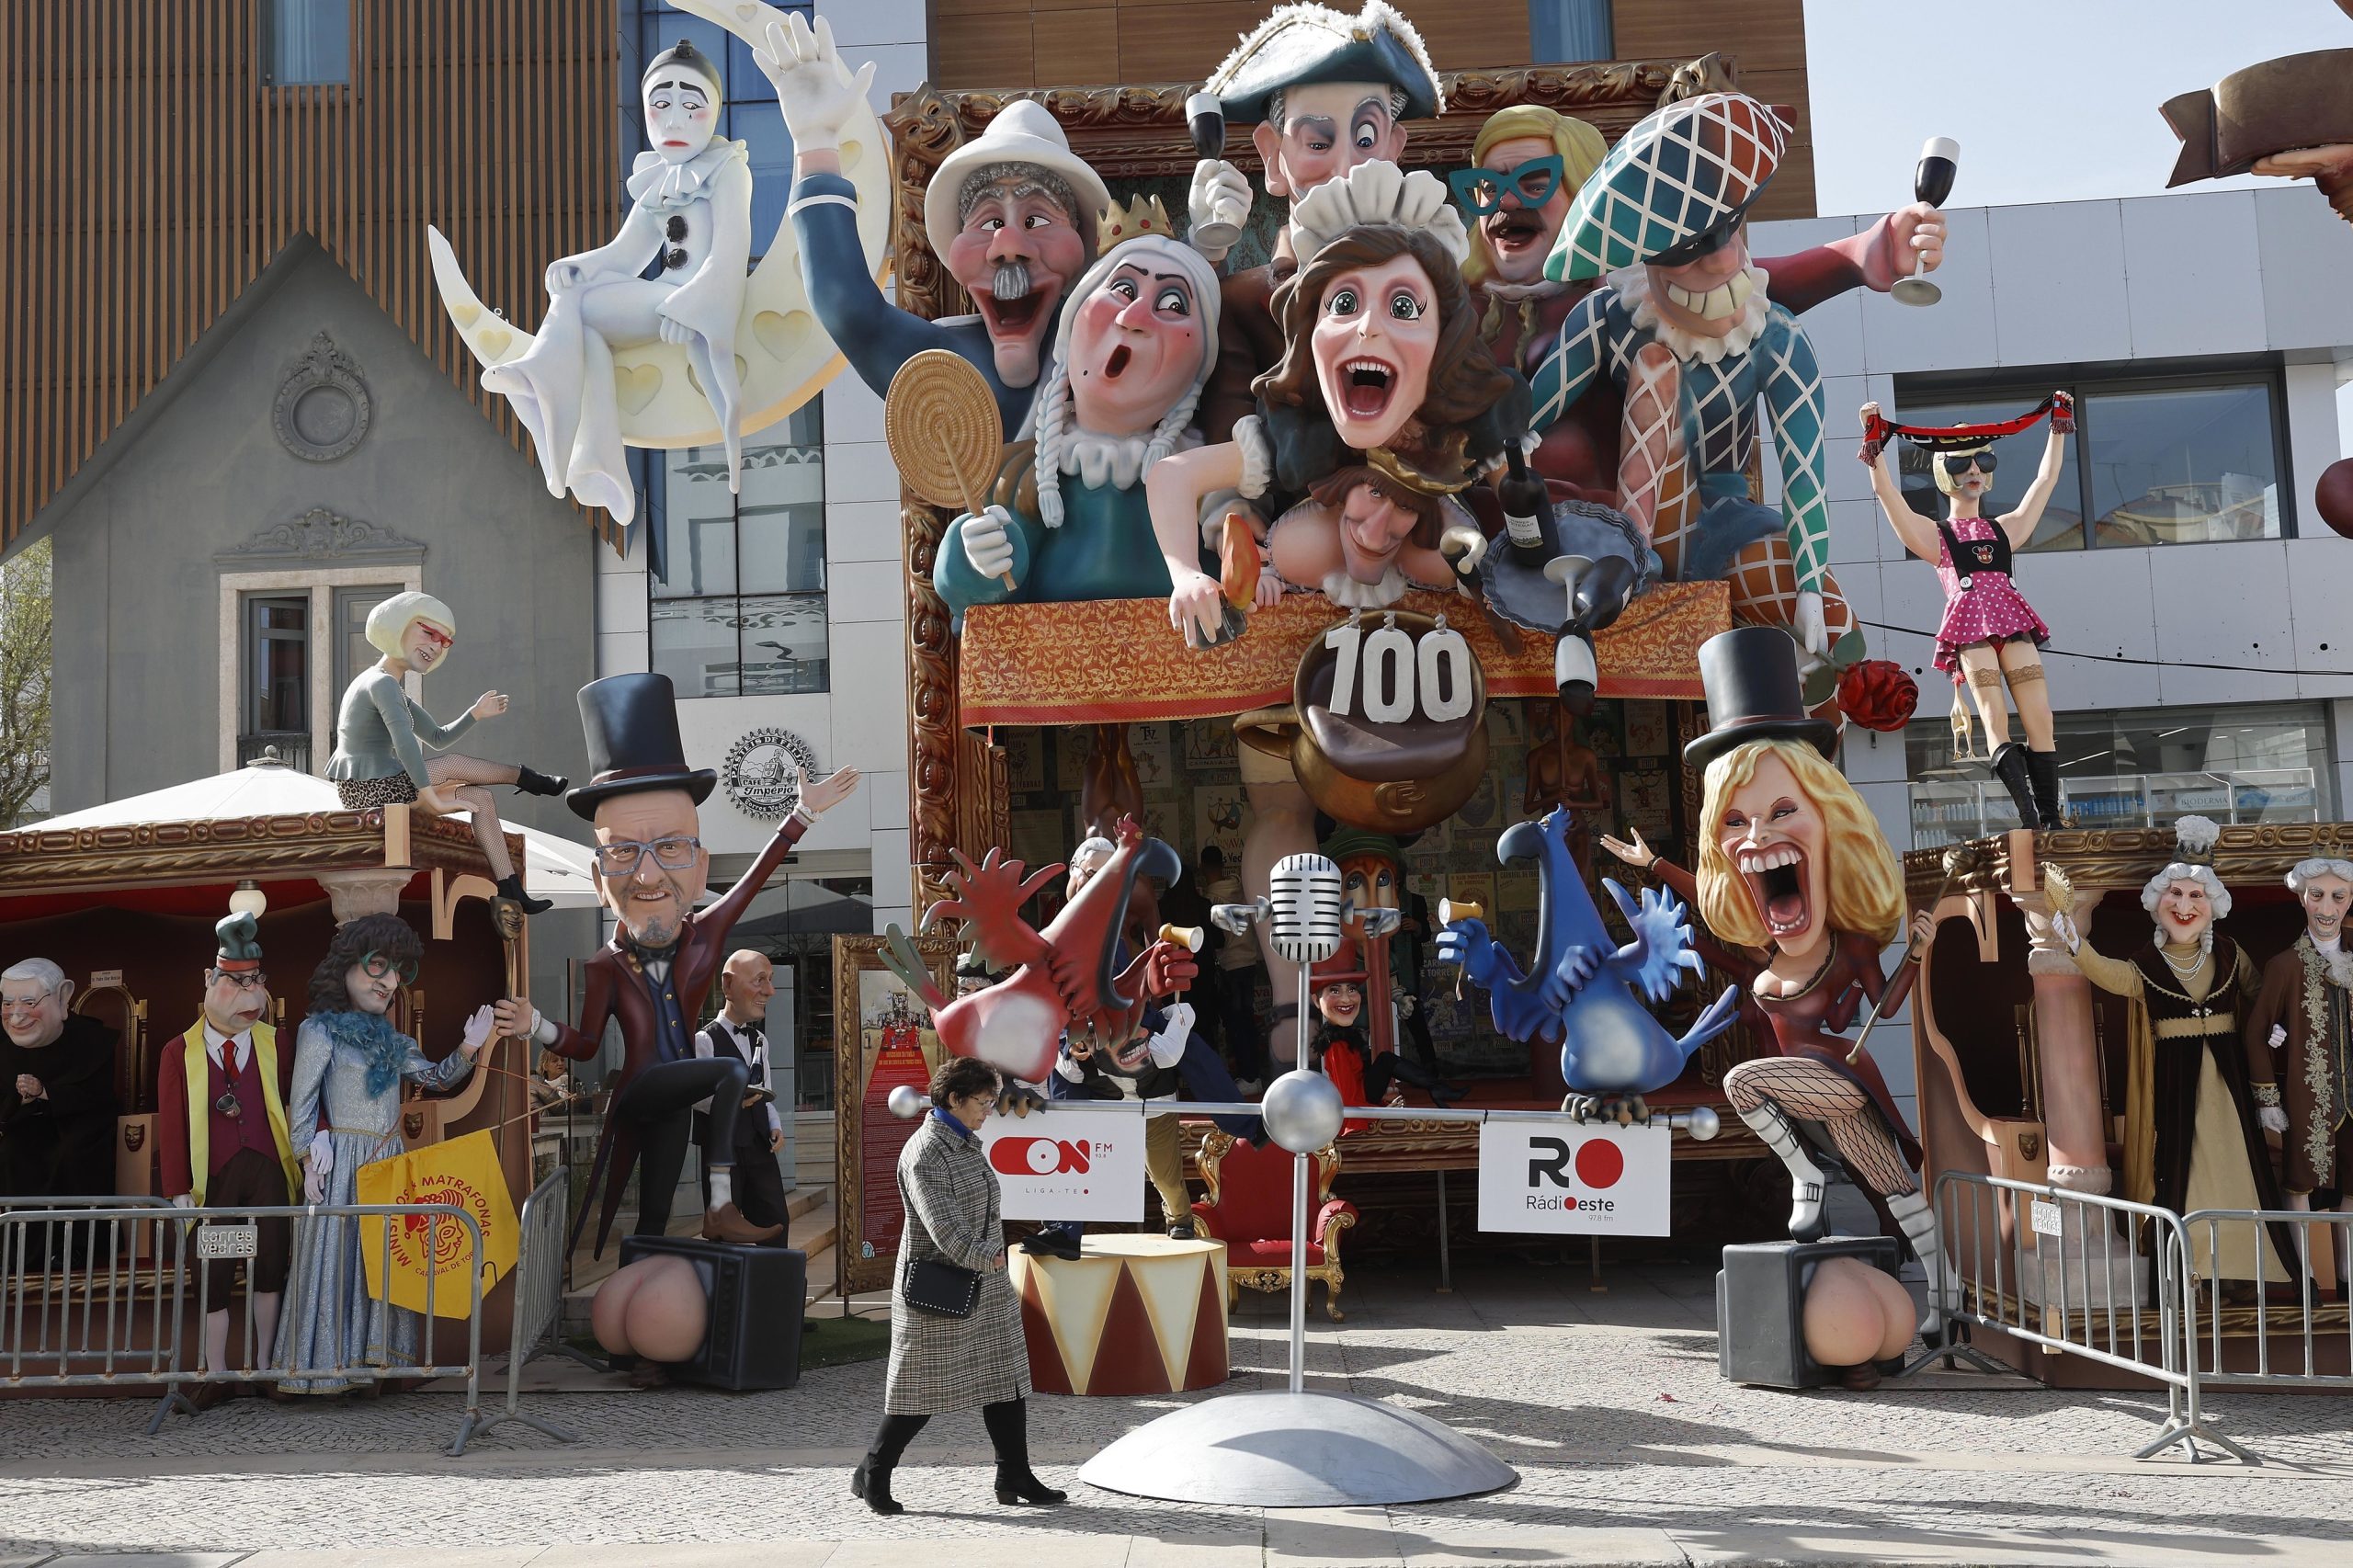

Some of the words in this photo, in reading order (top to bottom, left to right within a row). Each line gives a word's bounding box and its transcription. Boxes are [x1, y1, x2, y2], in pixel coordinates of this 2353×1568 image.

[1325, 625, 1473, 723] 100
[744, 784, 793, 797] Império
[2181, 797, 2228, 805] BIODERMA
[1227, 851, 1243, 863] Ved
[1095, 1142, 1113, 1153] FM
[1528, 1136, 1624, 1189] RO
[422, 1174, 494, 1238] MATRAFONAS
[1604, 1214, 1614, 1222] fm
[200, 1230, 253, 1243] torres
[200, 1239, 255, 1255] vedras
[415, 1267, 449, 1277] CARAVAL
[450, 1261, 461, 1270] DE
